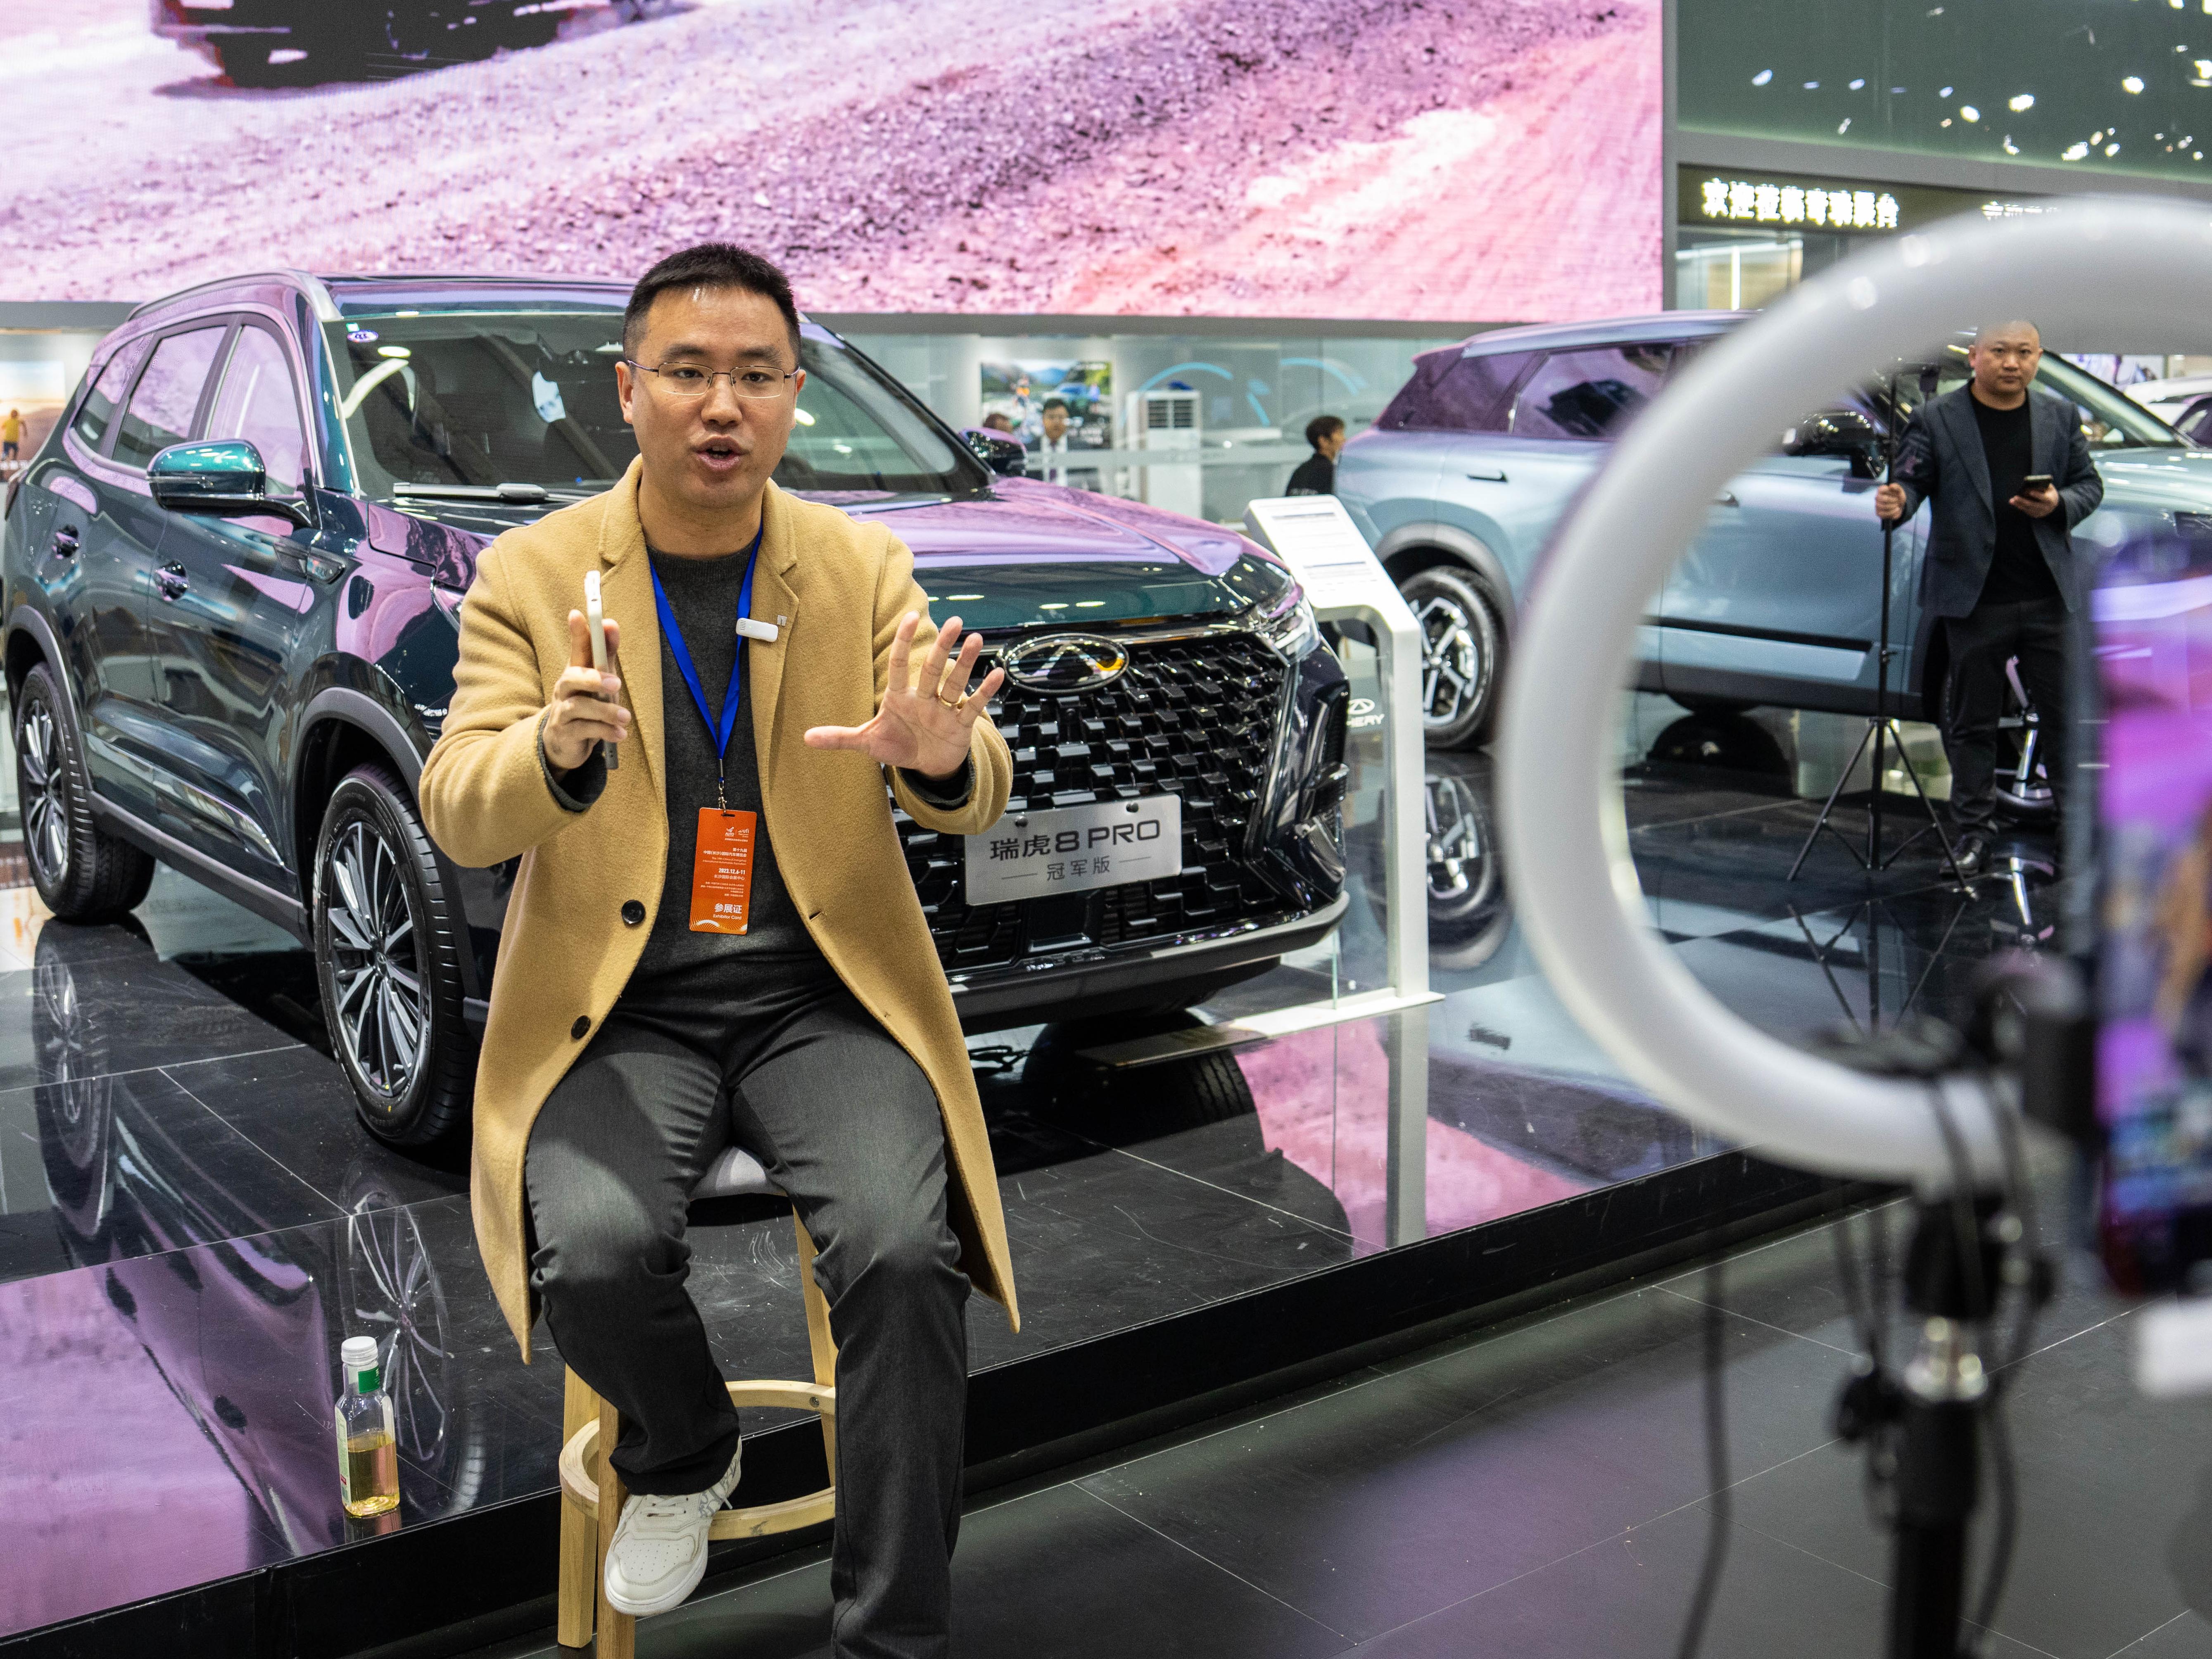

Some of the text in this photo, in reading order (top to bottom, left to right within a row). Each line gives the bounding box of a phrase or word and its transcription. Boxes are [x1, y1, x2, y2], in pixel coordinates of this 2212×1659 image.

[990, 819, 1160, 861] 瑞虎8 PRO
[1047, 856, 1110, 881] 冠军版
[715, 903, 742, 914] 参展证
